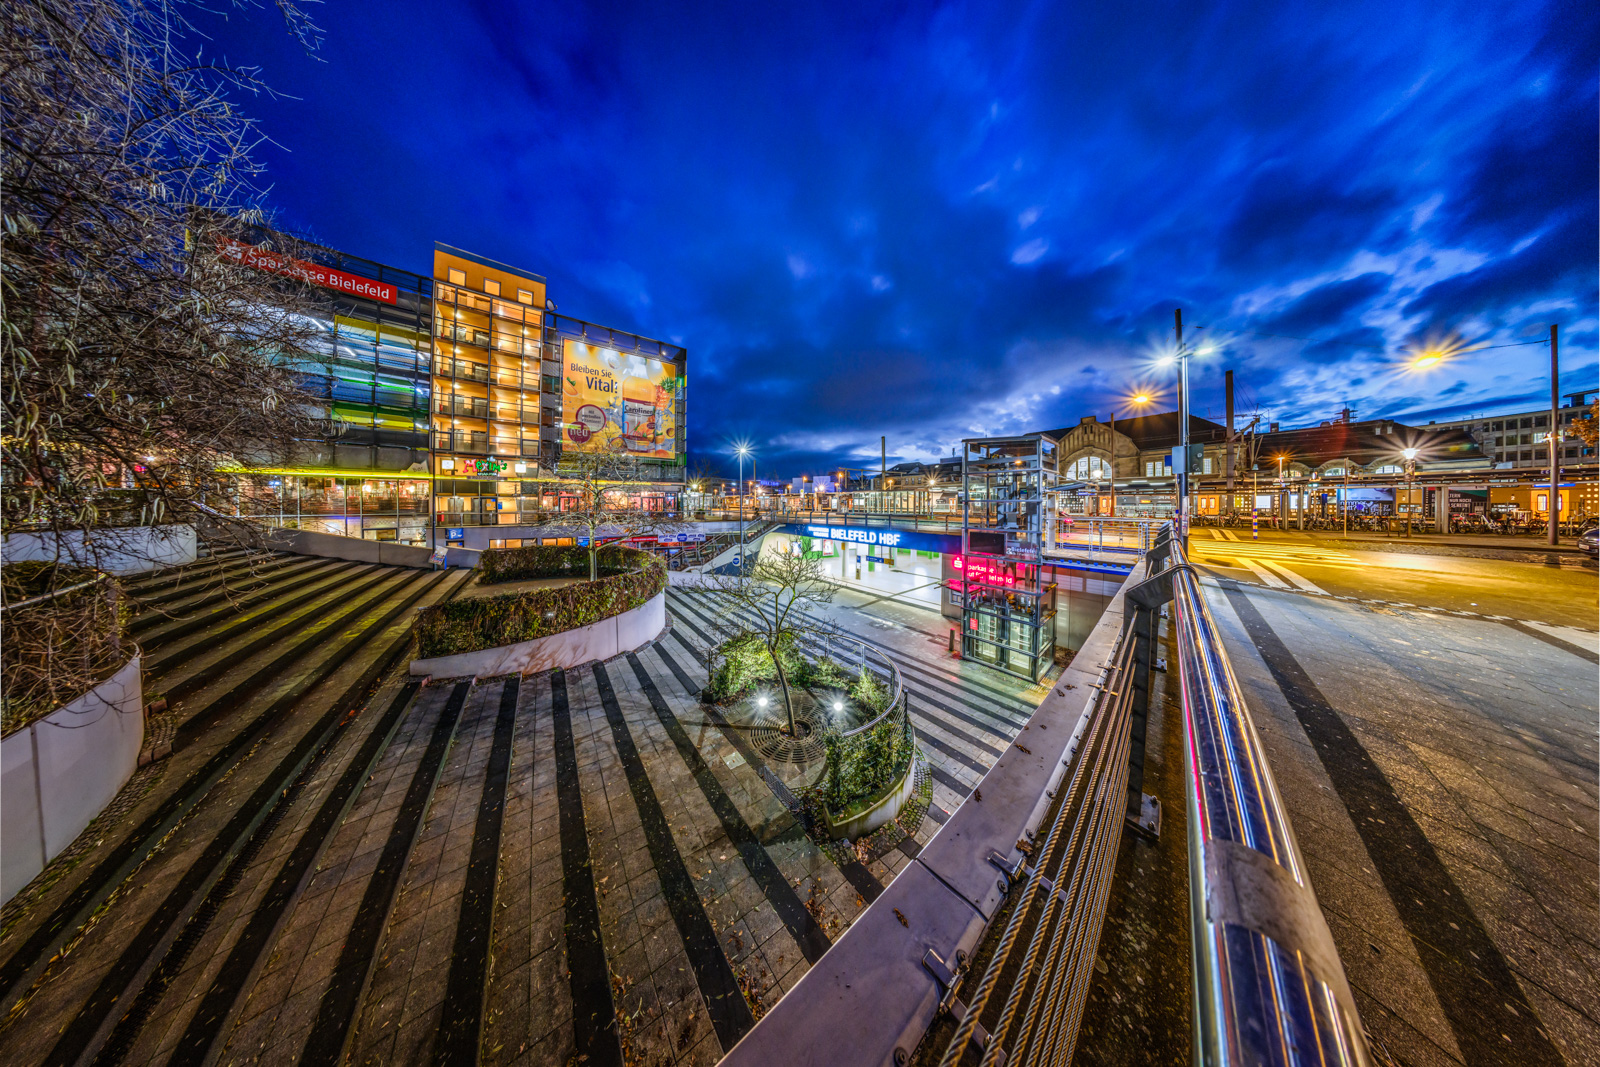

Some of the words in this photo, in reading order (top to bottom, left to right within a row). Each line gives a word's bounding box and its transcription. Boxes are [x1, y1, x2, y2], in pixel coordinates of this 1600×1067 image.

[248, 247, 325, 282] Sparasse
[329, 273, 390, 299] Bielefeld
[570, 362, 600, 376] Bleiben
[601, 369, 612, 378] Sie
[586, 376, 618, 394] Vital!
[570, 429, 588, 437] neu
[830, 527, 877, 543] BIELEFELD
[878, 532, 901, 546] HBF
